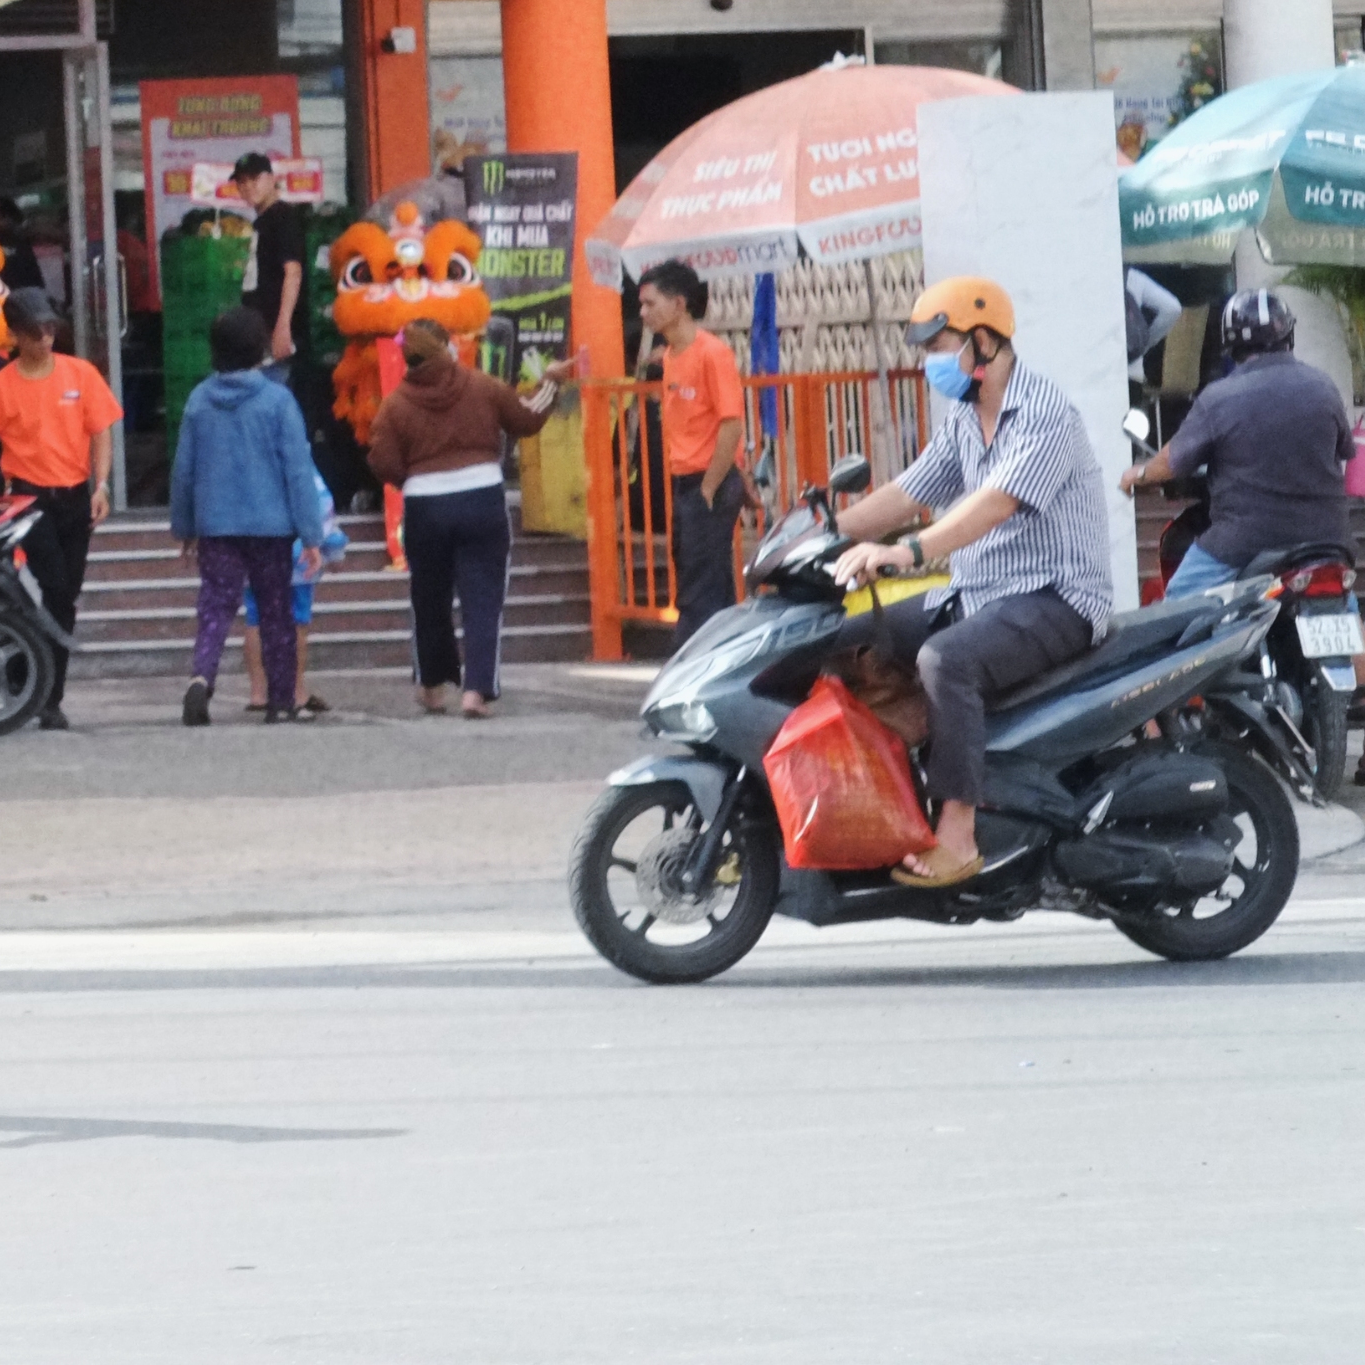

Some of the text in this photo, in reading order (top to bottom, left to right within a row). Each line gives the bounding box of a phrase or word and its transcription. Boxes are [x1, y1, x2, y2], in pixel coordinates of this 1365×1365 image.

[808, 168, 878, 198] CHẤT
[1226, 189, 1260, 213] GÓP
[485, 224, 550, 248] KHI MUA
